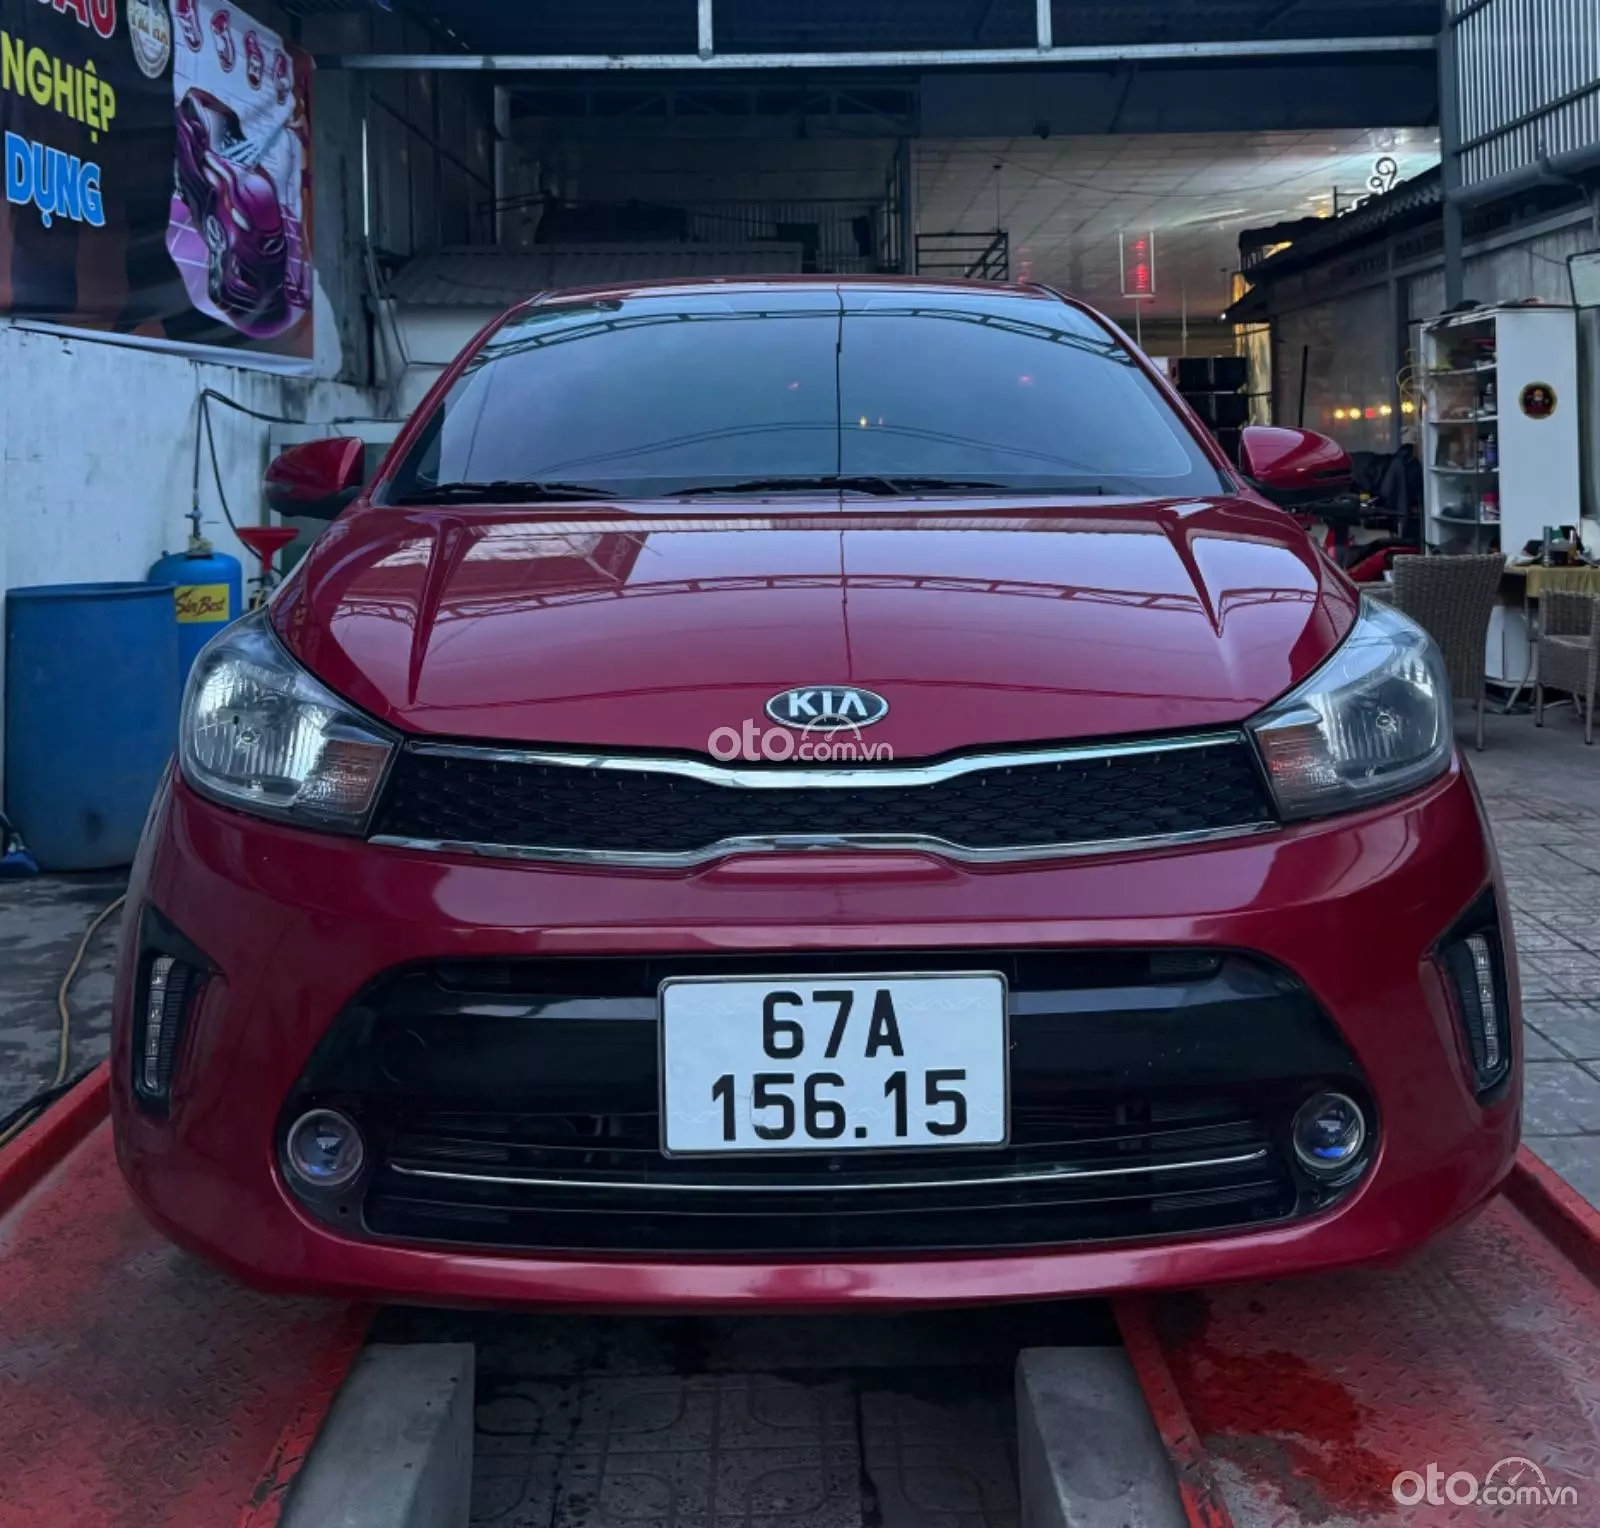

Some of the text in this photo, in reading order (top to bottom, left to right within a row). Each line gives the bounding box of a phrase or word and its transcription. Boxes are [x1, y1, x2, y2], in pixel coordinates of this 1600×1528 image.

[1, 30, 117, 144] NGHIỆP
[5, 130, 107, 229] DỤNG
[788, 691, 868, 717] KIA
[762, 989, 905, 1060] 67A
[711, 1068, 968, 1142] 156.15
